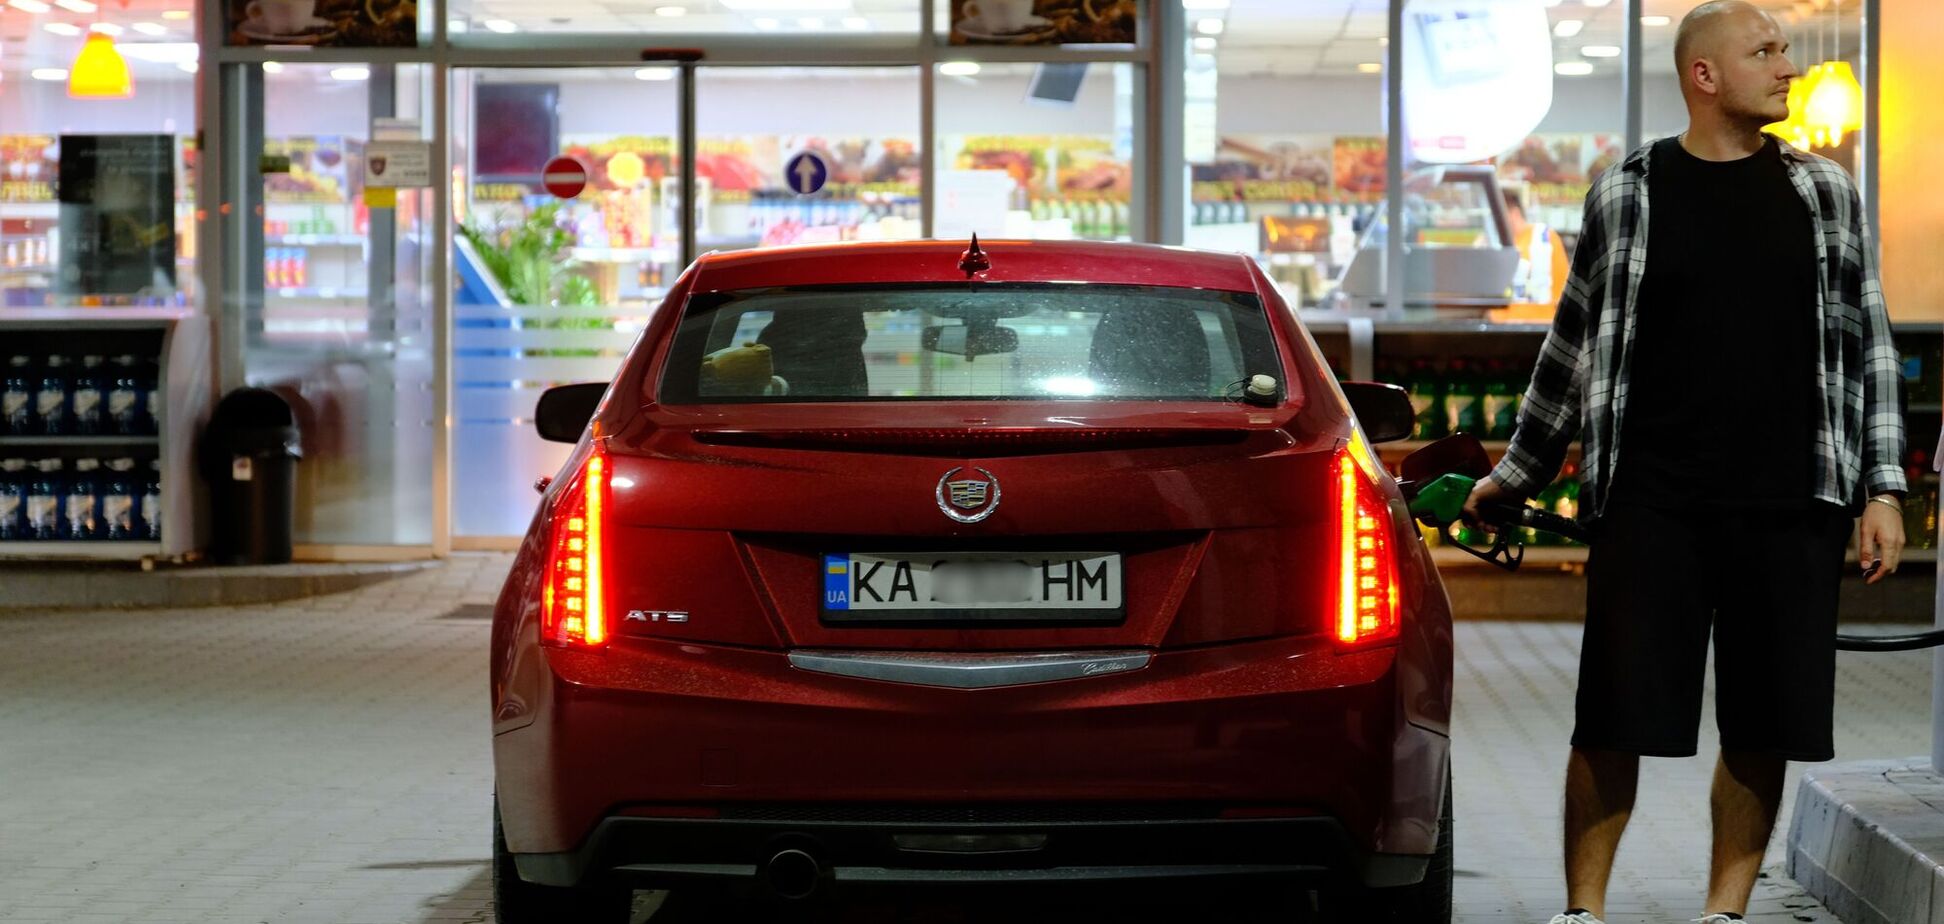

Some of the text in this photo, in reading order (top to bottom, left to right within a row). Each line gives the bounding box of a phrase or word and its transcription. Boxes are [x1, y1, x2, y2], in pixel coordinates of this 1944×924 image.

[853, 561, 918, 603] KA
[1042, 559, 1108, 602] HM
[827, 590, 847, 603] UA
[623, 609, 689, 622] ATS
